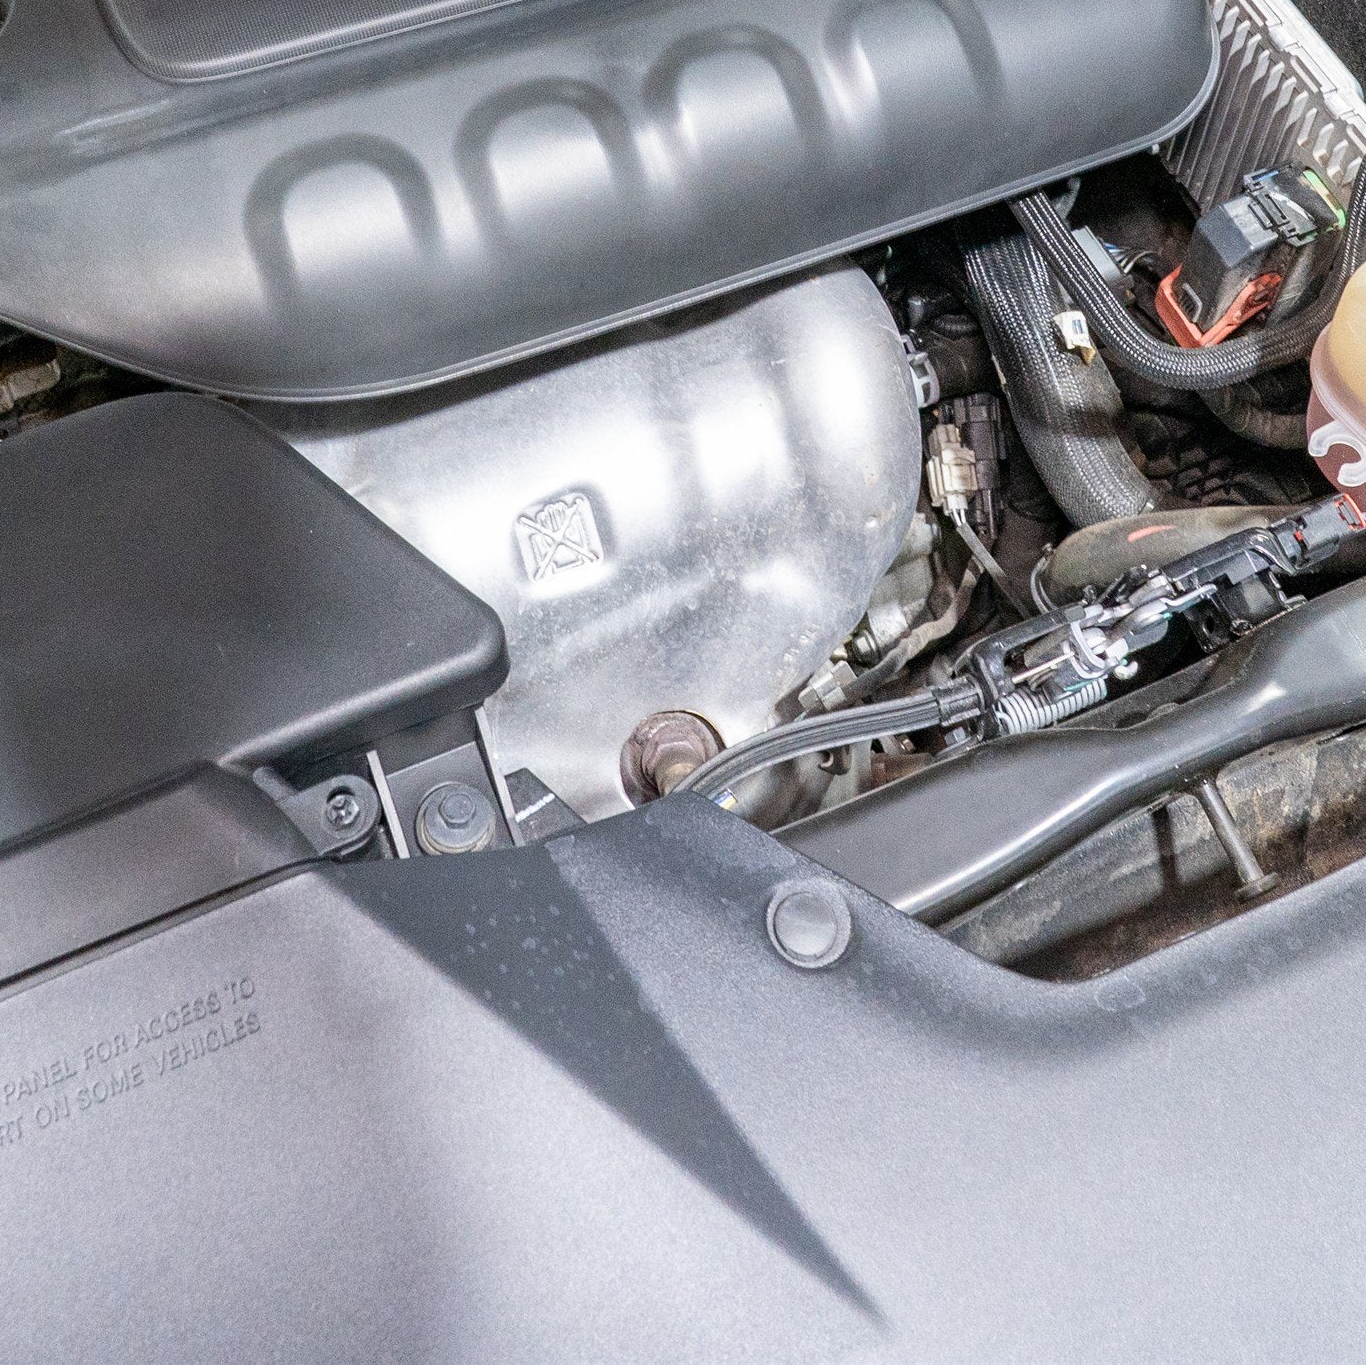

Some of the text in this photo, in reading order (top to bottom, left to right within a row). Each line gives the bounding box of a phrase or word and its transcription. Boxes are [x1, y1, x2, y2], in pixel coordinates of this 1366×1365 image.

[2, 1056, 78, 1107] PANEL
[81, 1032, 130, 1070] FOR
[133, 989, 223, 1050] ACCESS
[222, 974, 257, 1005] TO
[34, 1095, 71, 1130] ON
[77, 1063, 146, 1113] SOME
[153, 1010, 263, 1078] VEHICLES
